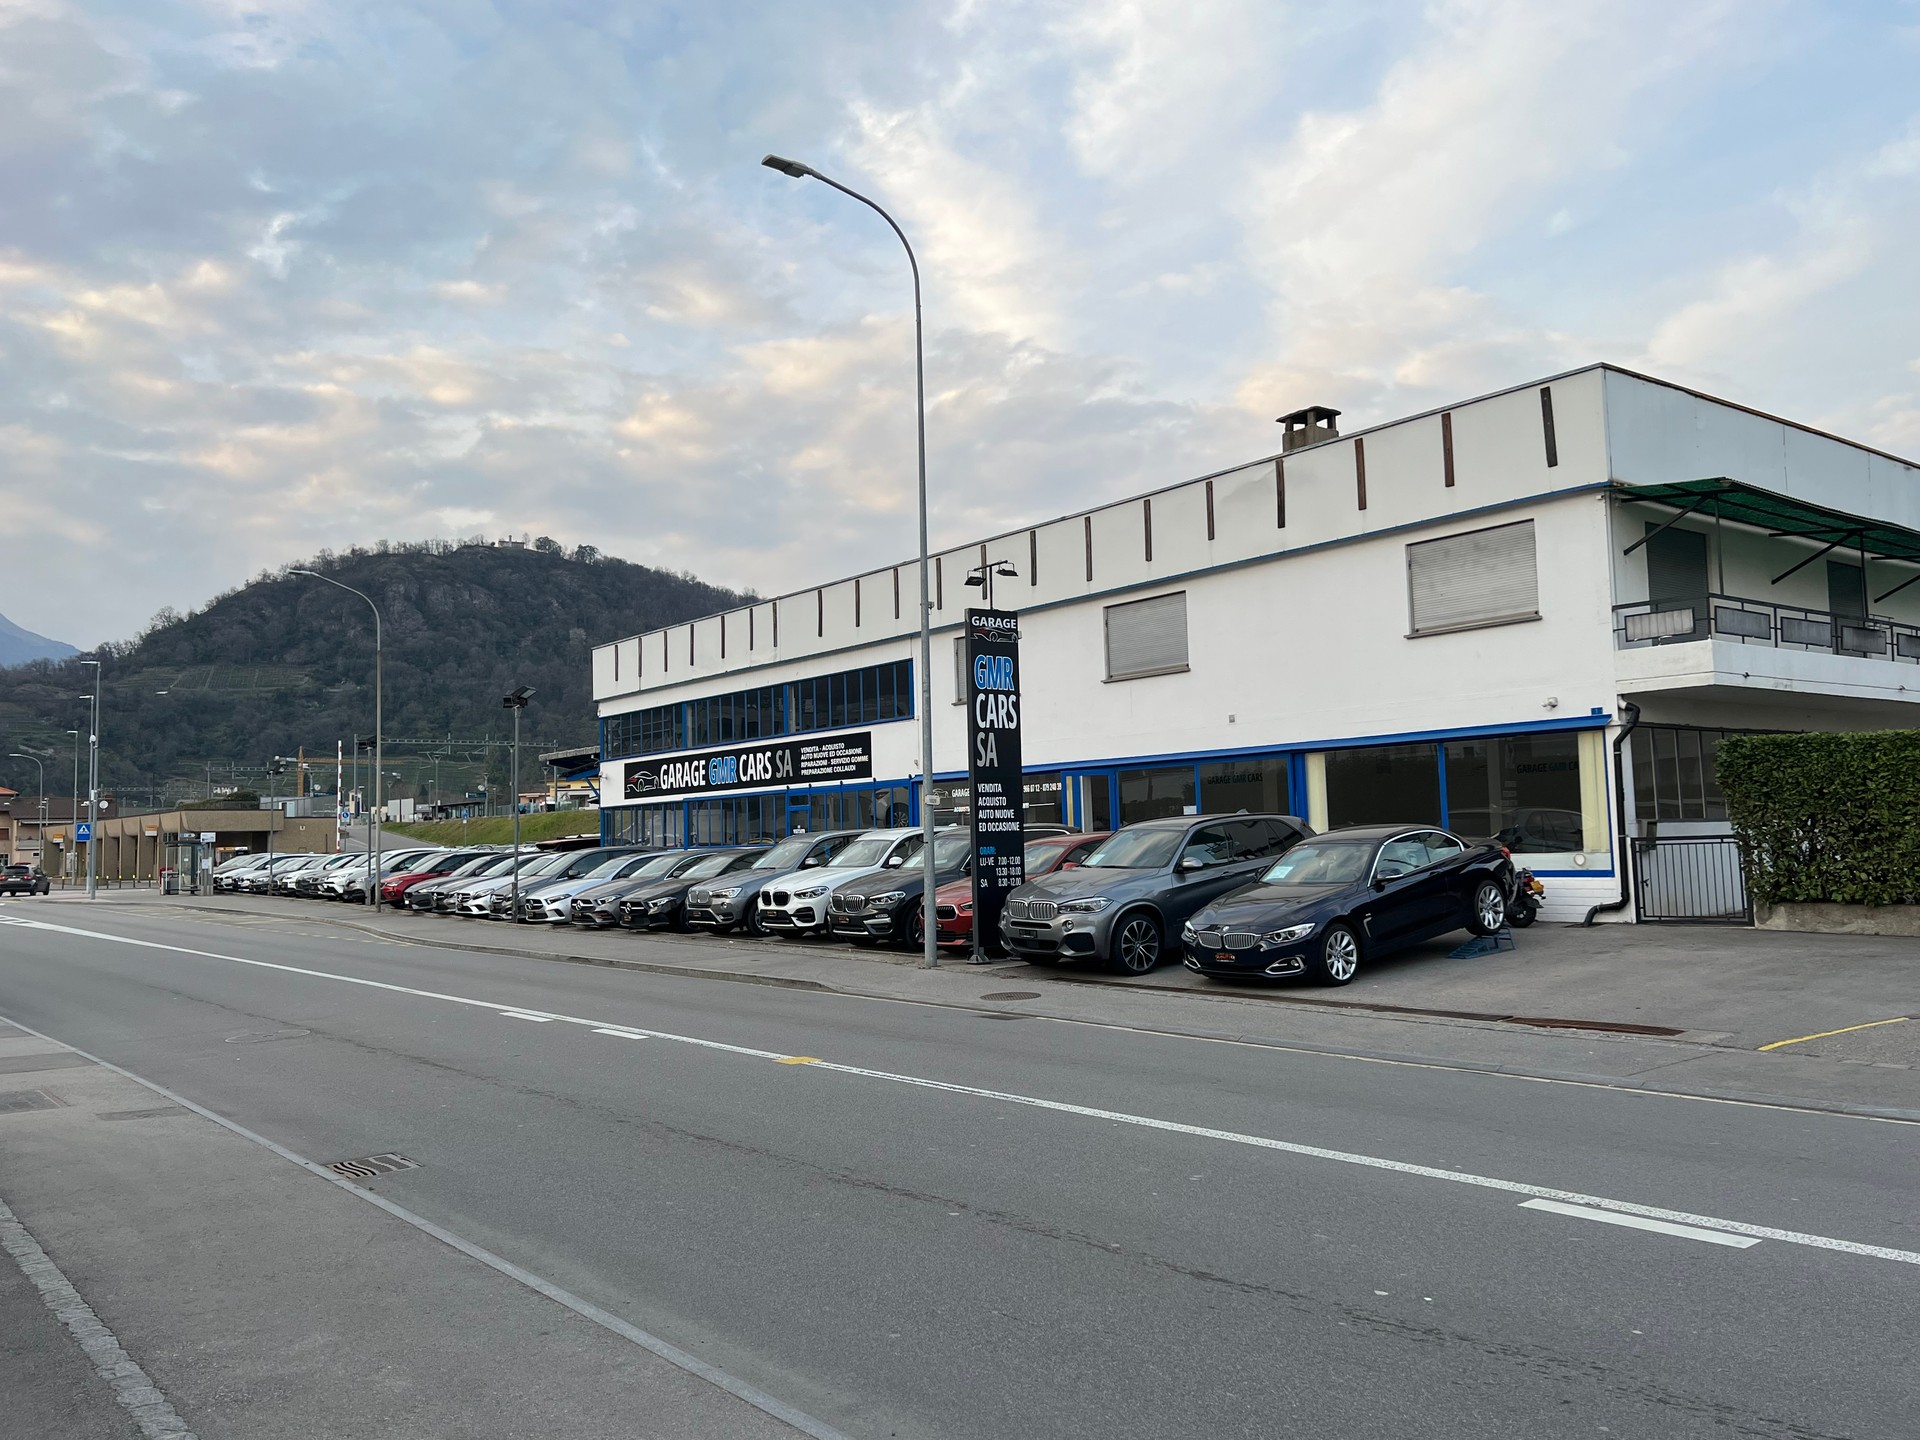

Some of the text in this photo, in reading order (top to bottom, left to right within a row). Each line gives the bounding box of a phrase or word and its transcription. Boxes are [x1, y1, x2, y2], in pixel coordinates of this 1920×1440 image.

[971, 616, 1017, 629] GARAGE
[974, 654, 1015, 691] GMR
[976, 693, 1018, 729] CARS
[822, 743, 845, 751] ACQUISTO
[836, 747, 862, 756] OCCASIONE
[976, 731, 998, 768] SA
[800, 759, 827, 768] RIPARAZIONI
[830, 757, 850, 765] SERVIZIO
[851, 755, 869, 763] GOMME
[660, 749, 793, 790] GARAGE GMR CARS SA
[800, 764, 856, 776] PREPARAZIONE COLLAUDI
[951, 788, 970, 798] GARAGE
[977, 783, 1002, 793] VENDITA
[978, 796, 1007, 806] ACQUISTO
[978, 809, 1015, 819] AUTO NUOVE
[979, 821, 1020, 832] ED OCCASIONE
[979, 857, 995, 866] LU-VE
[980, 878, 988, 888] SA
